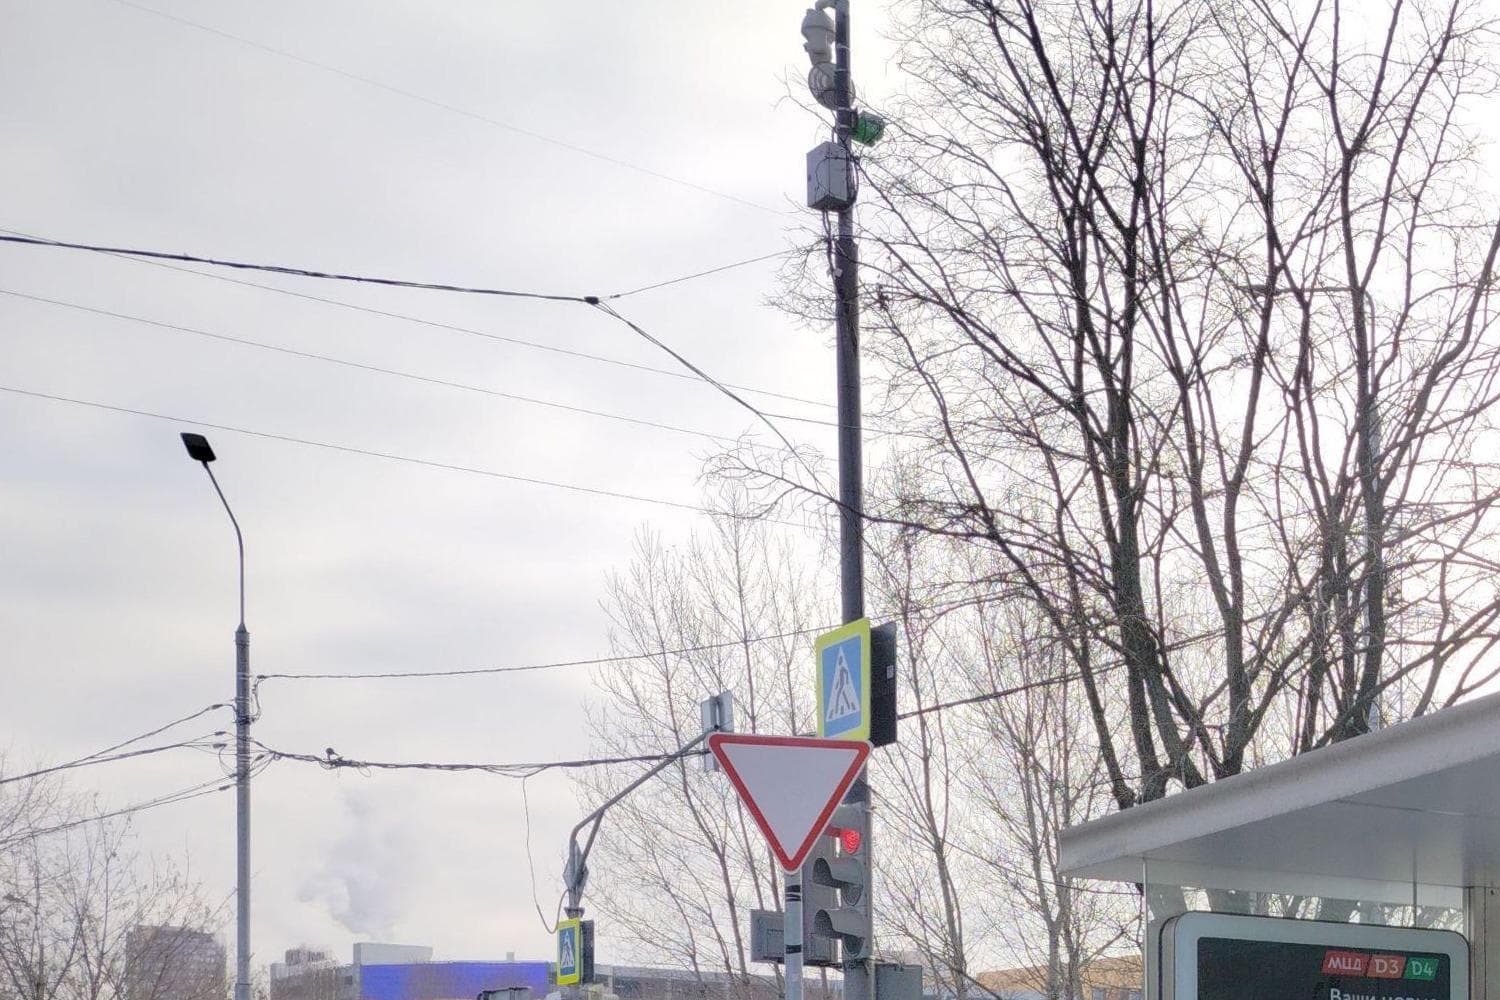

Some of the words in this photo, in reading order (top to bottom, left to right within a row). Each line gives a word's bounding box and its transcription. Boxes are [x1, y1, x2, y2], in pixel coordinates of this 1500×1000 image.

[1327, 957, 1362, 971] МЦД
[1374, 958, 1399, 974] D3
[1412, 960, 1434, 977] D4
